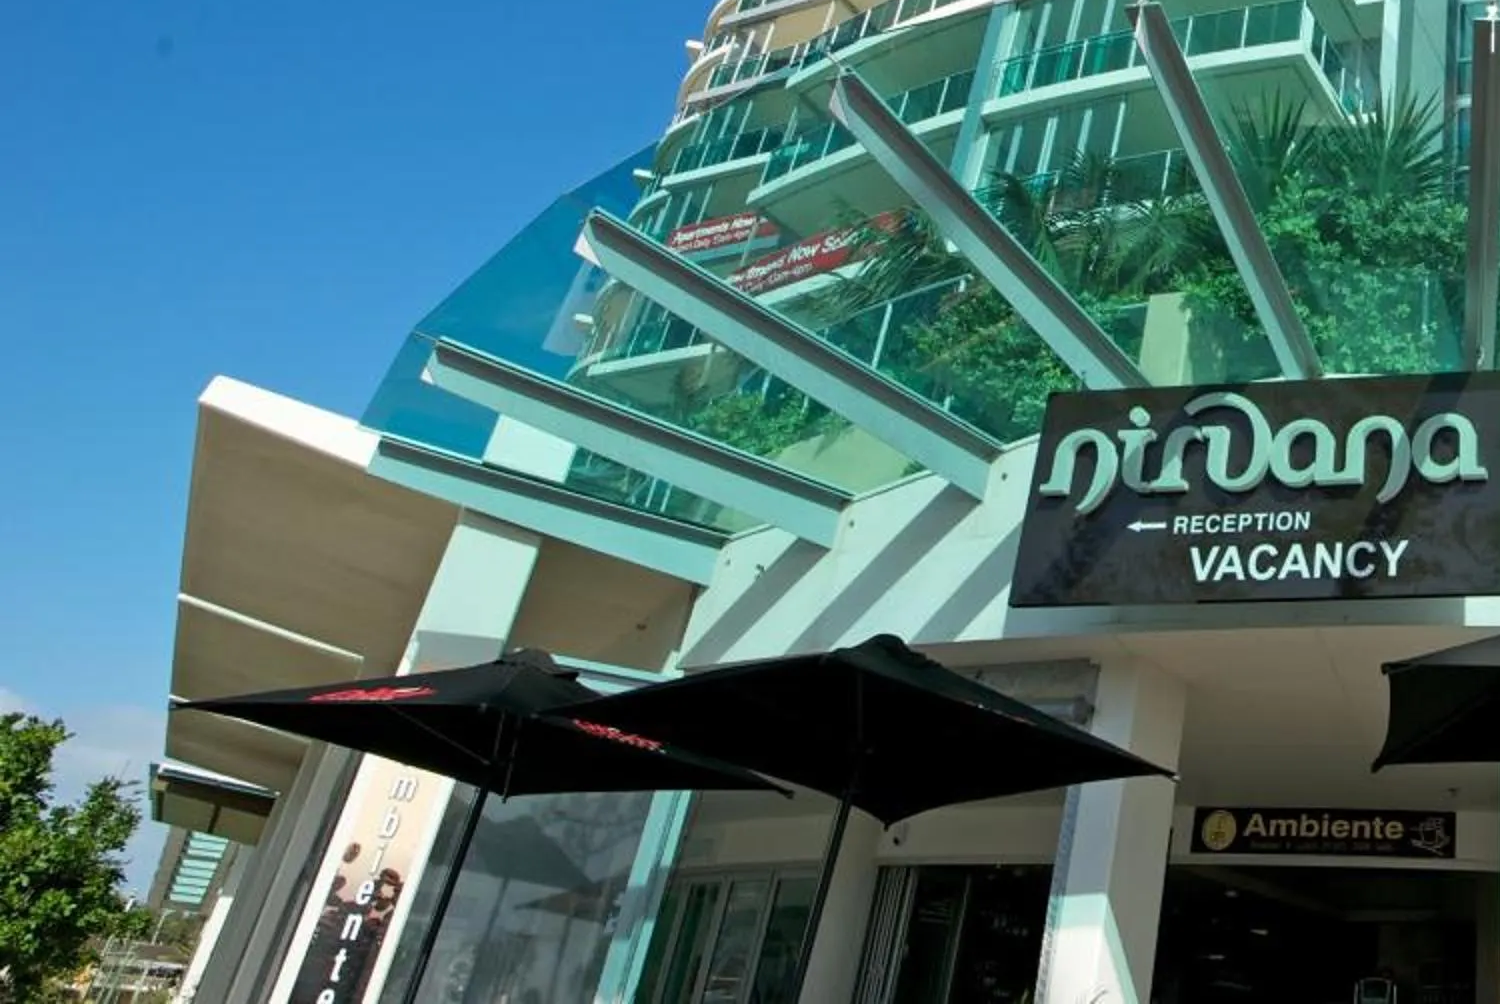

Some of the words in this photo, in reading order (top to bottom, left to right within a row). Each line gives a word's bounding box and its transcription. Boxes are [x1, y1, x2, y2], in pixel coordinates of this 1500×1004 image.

[1039, 392, 1488, 514] nirvana
[1172, 510, 1312, 535] RECEPTION
[1190, 539, 1409, 582] VACANCY
[1243, 812, 1405, 840] Ambiente
[315, 774, 418, 1004] mbiente
